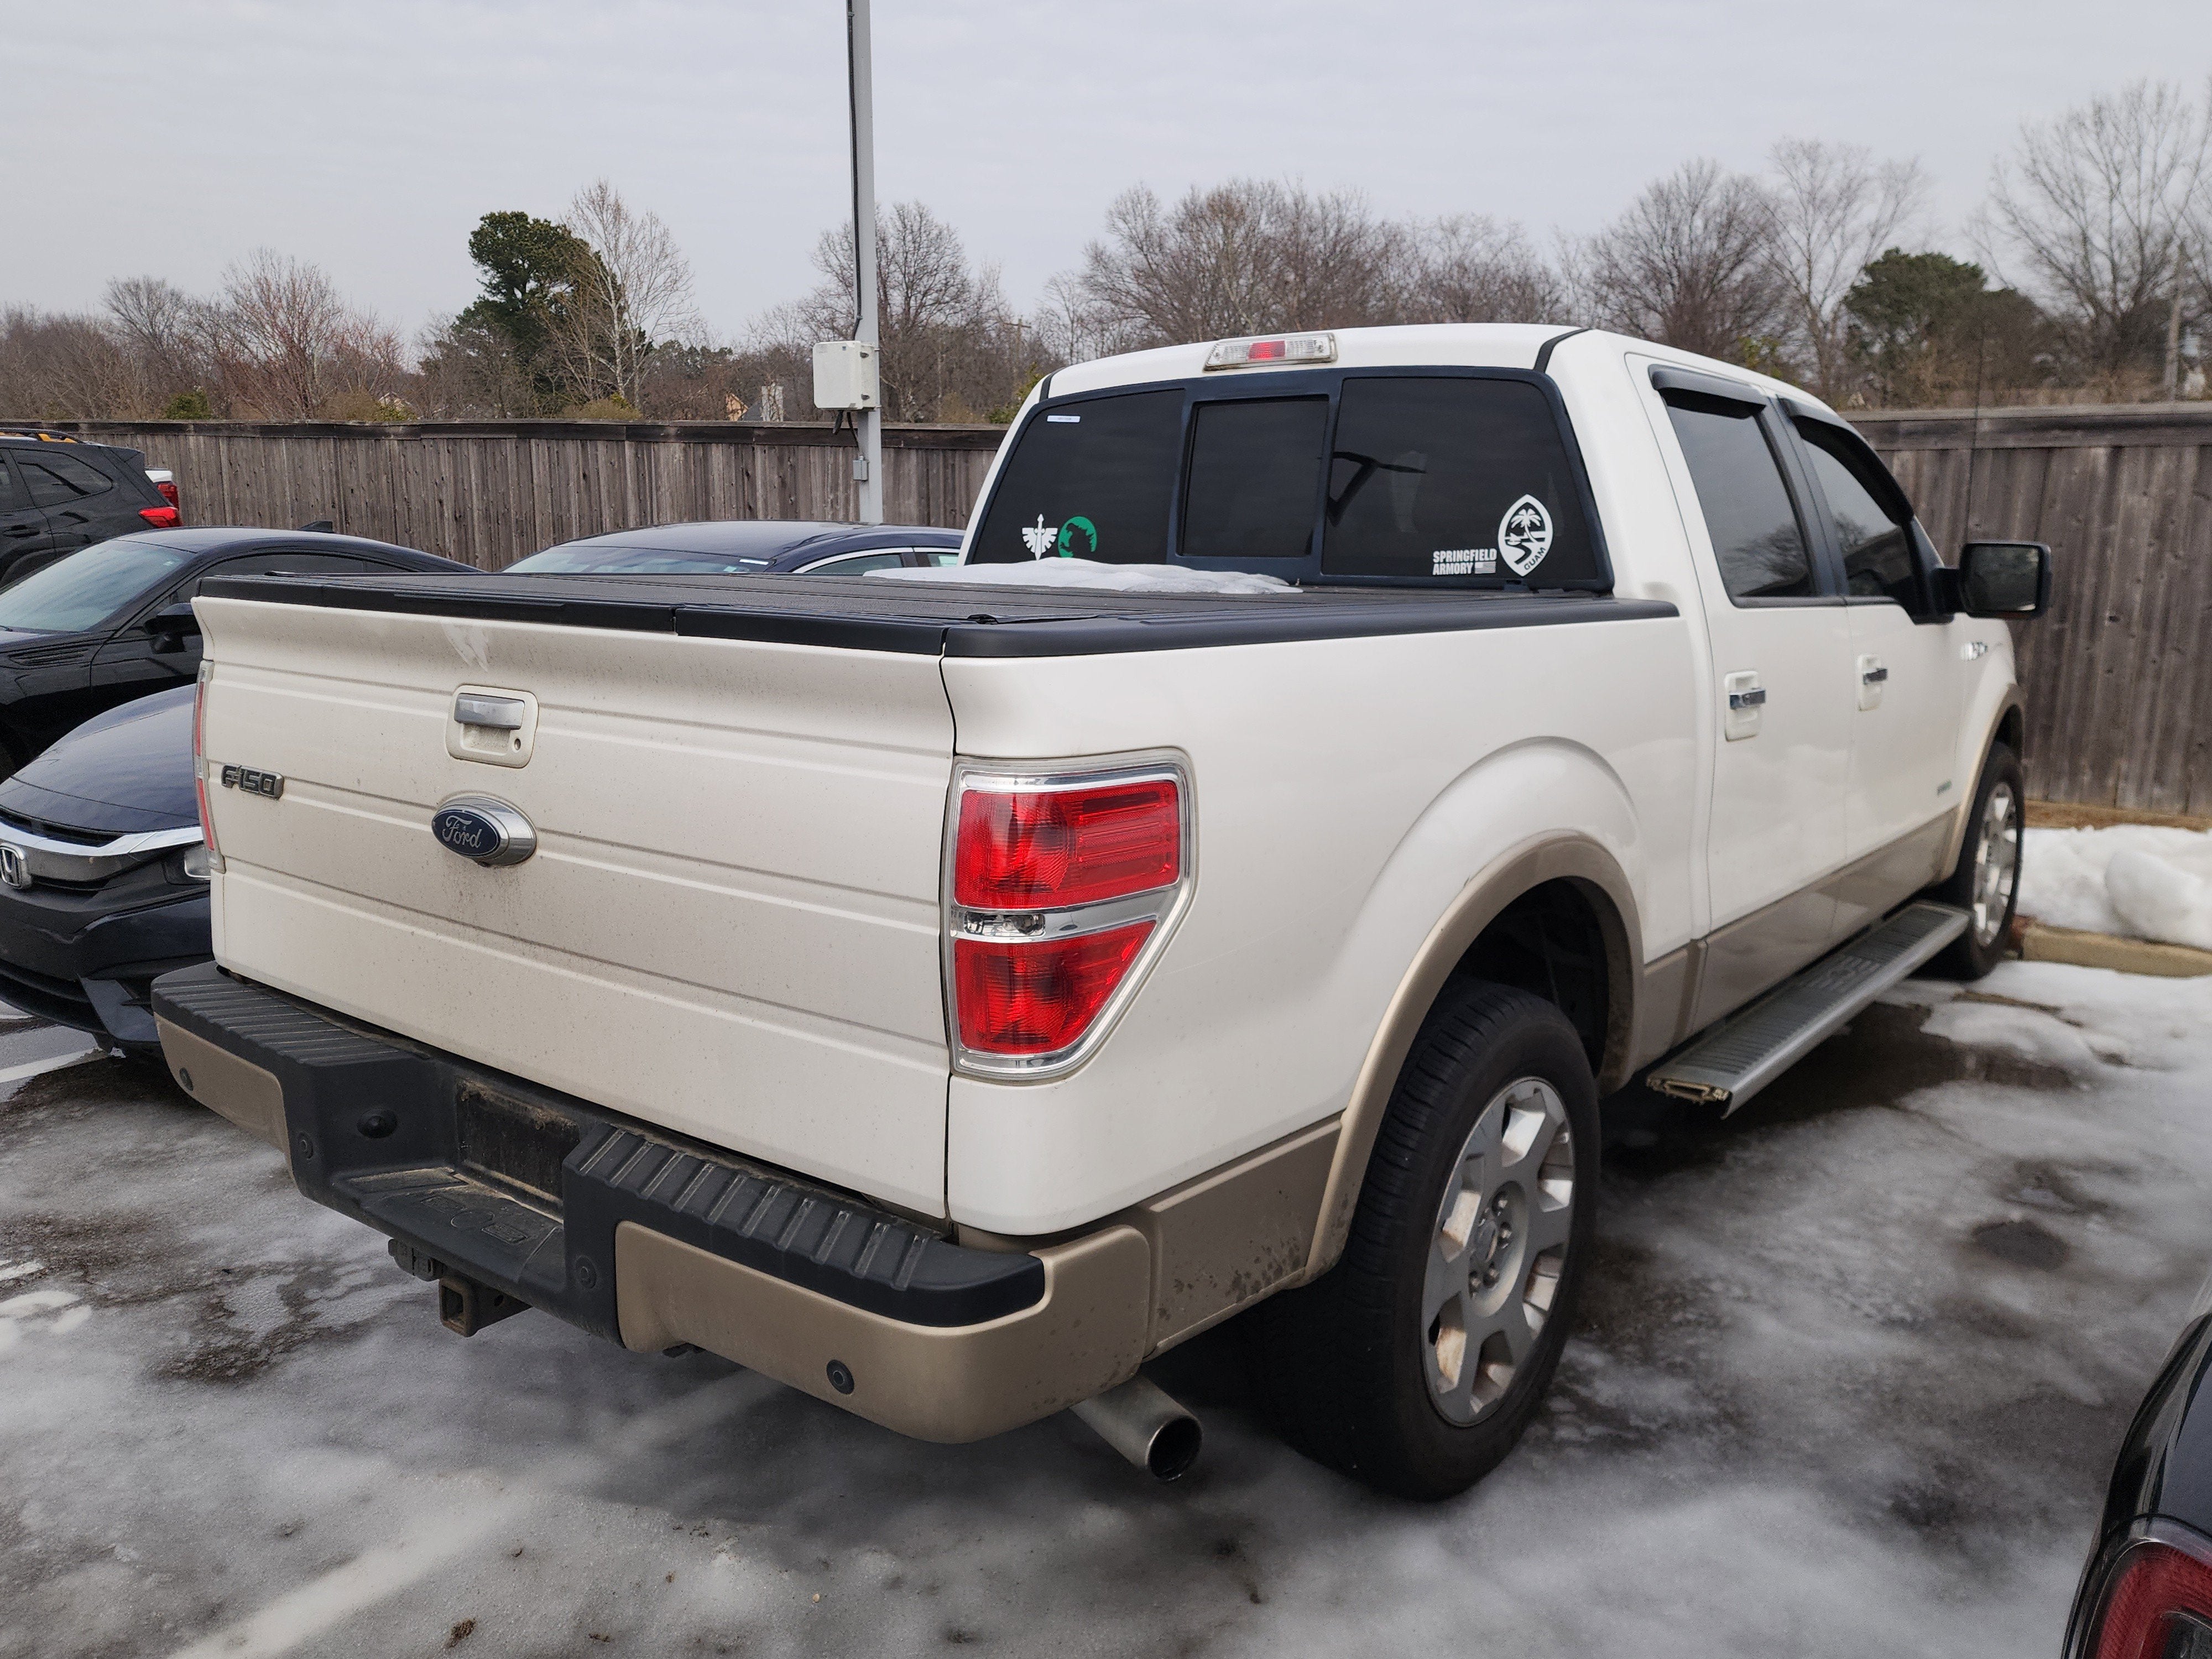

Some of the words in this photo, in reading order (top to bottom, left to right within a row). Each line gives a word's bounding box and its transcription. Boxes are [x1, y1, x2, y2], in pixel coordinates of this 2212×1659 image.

[1432, 547, 1498, 563] SPRINGFIELD
[1524, 547, 1546, 570] GUAM
[1432, 561, 1474, 576] ARMORY
[221, 762, 284, 800] F-150
[442, 815, 483, 849] Ford
